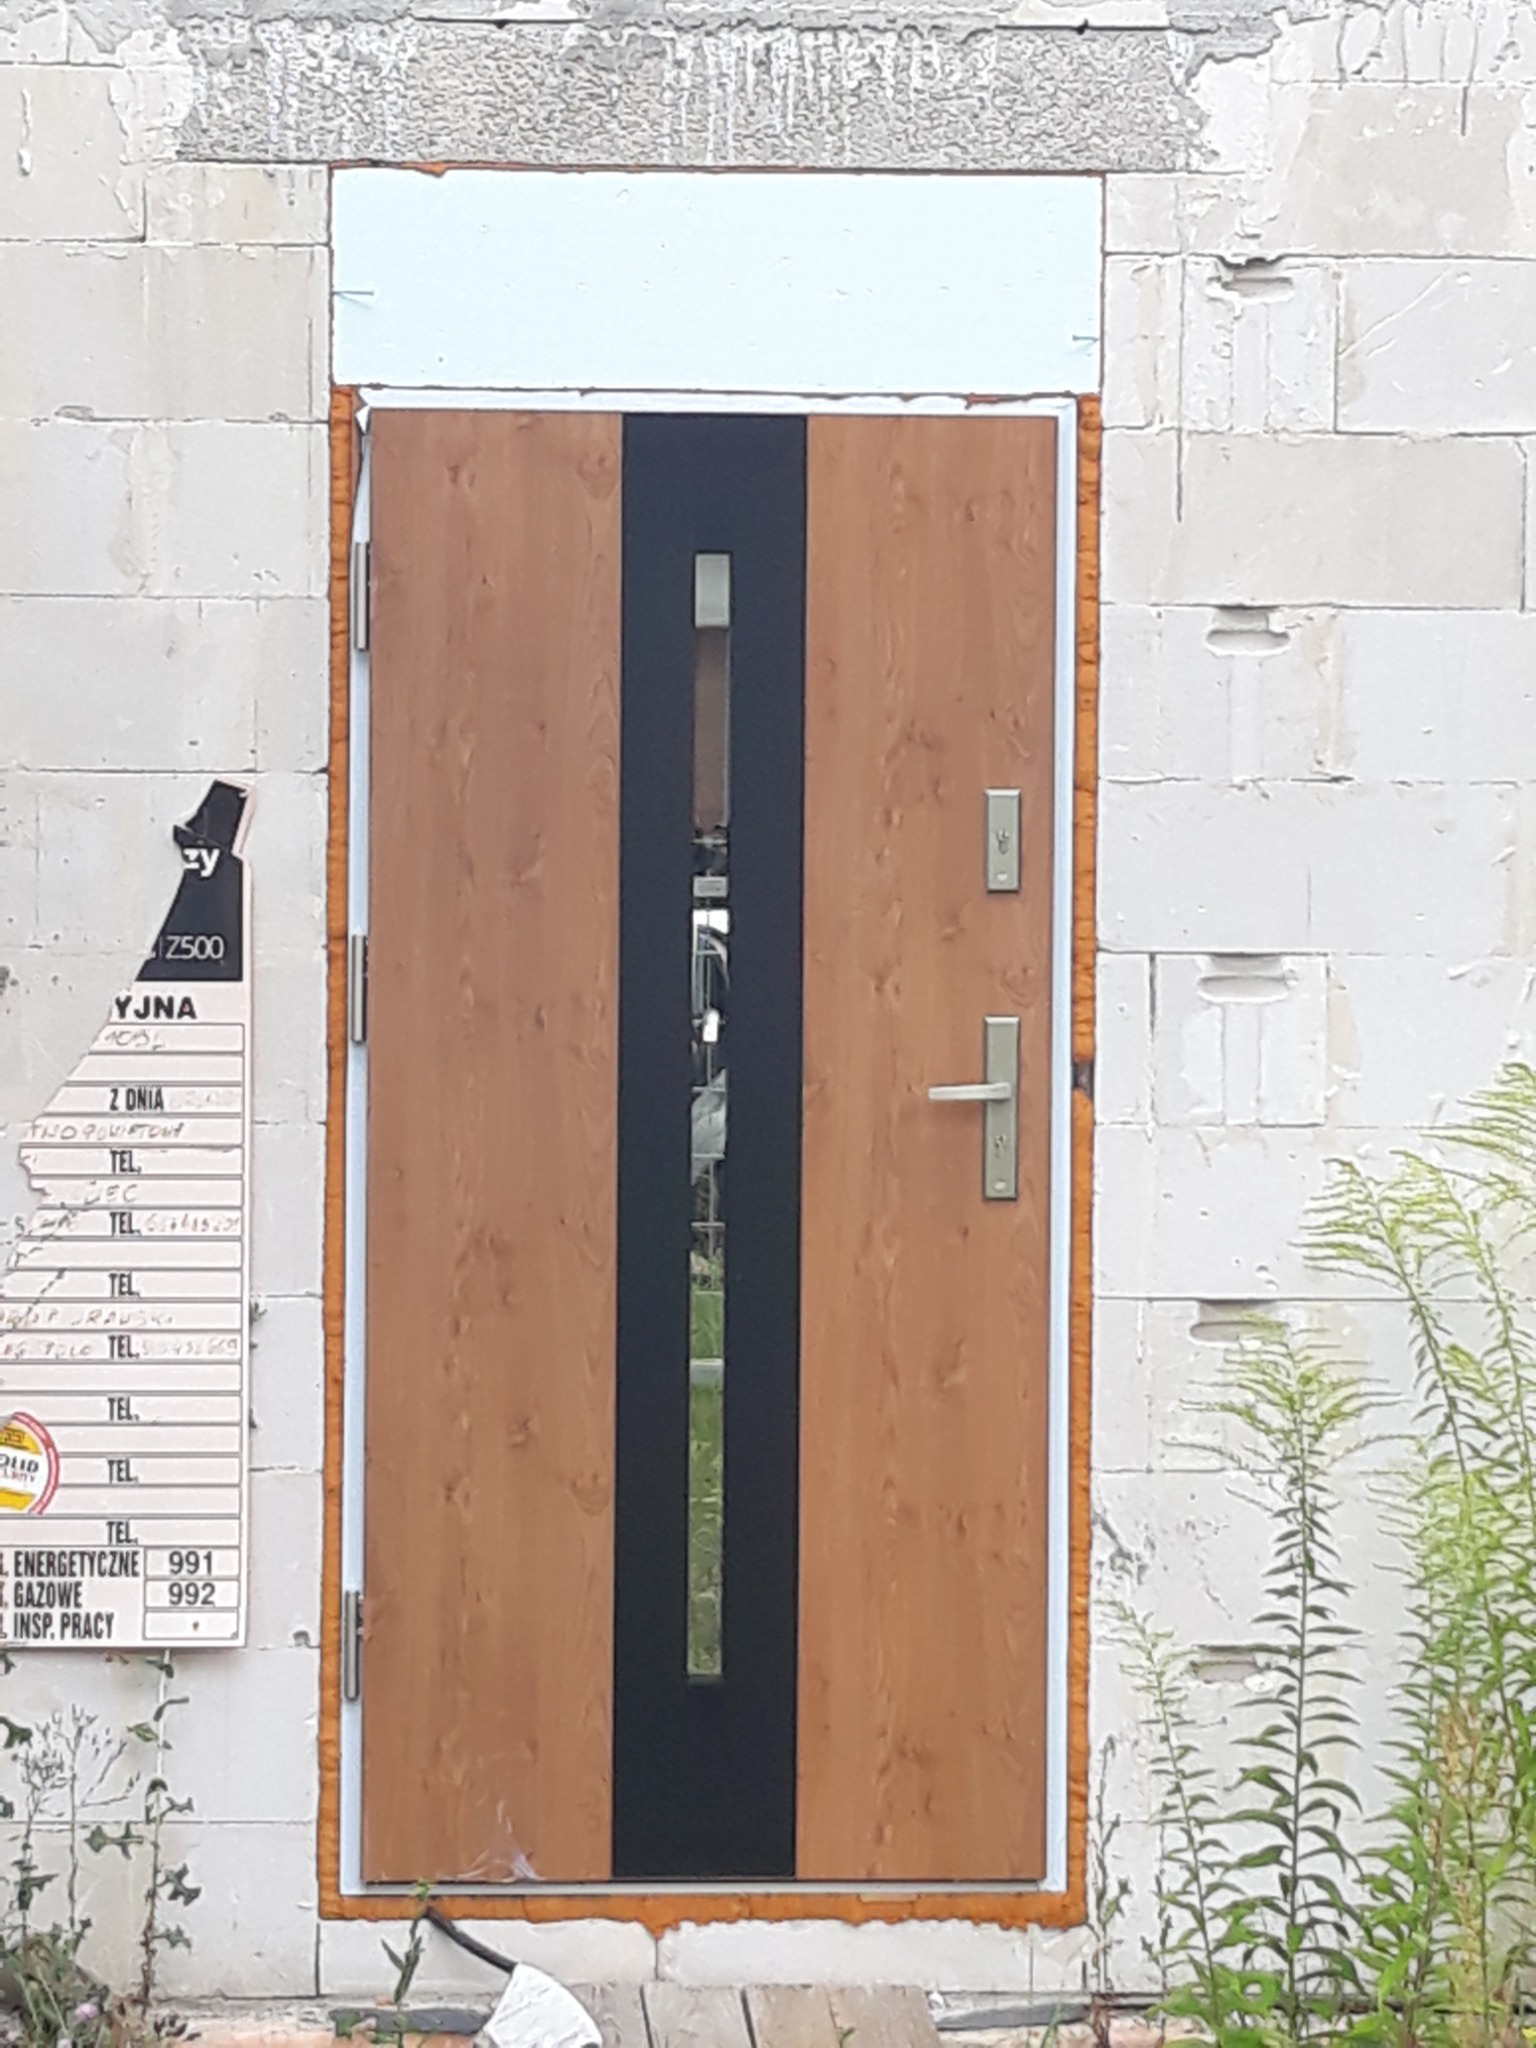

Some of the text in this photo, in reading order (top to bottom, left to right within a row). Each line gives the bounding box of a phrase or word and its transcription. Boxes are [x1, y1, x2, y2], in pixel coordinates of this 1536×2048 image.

[165, 936, 225, 960] Z500
[114, 995, 197, 1020] YJNA
[110, 1087, 119, 1111] Z
[125, 1086, 164, 1112] DNIA
[14, 1550, 140, 1578] ENERGETYCZNE
[169, 1550, 212, 1575] 991
[14, 1581, 83, 1609] GAZOWE
[168, 1582, 216, 1606] 992
[14, 1612, 55, 1640] INSP.
[60, 1612, 114, 1640] PRACY
